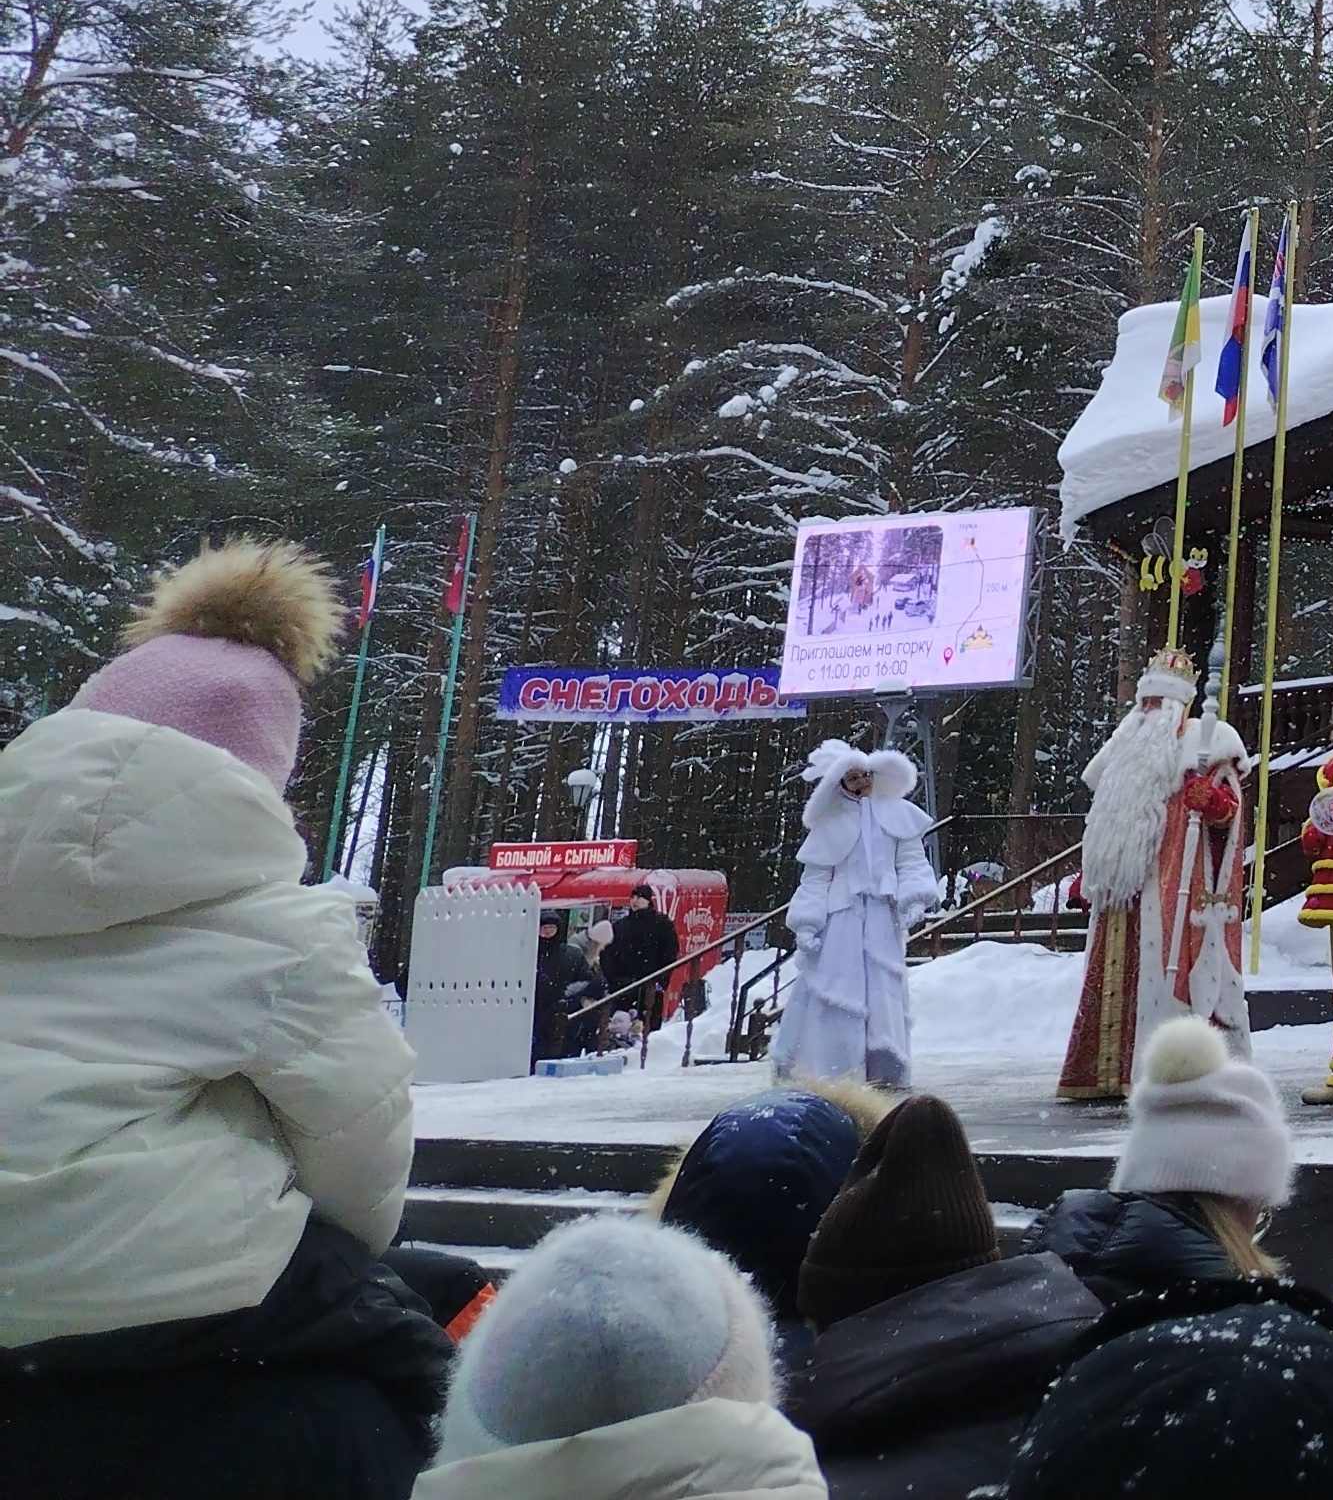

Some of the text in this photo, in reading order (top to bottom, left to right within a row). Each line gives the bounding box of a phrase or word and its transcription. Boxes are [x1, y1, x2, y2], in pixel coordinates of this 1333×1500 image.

[986, 582, 1000, 593] 250
[790, 640, 933, 665] Приглашаем на горку
[808, 660, 908, 680] с 11:00 до 16:00
[496, 846, 552, 867] БОЛЬШОЙ
[564, 844, 615, 865] СЫТНЫЙ
